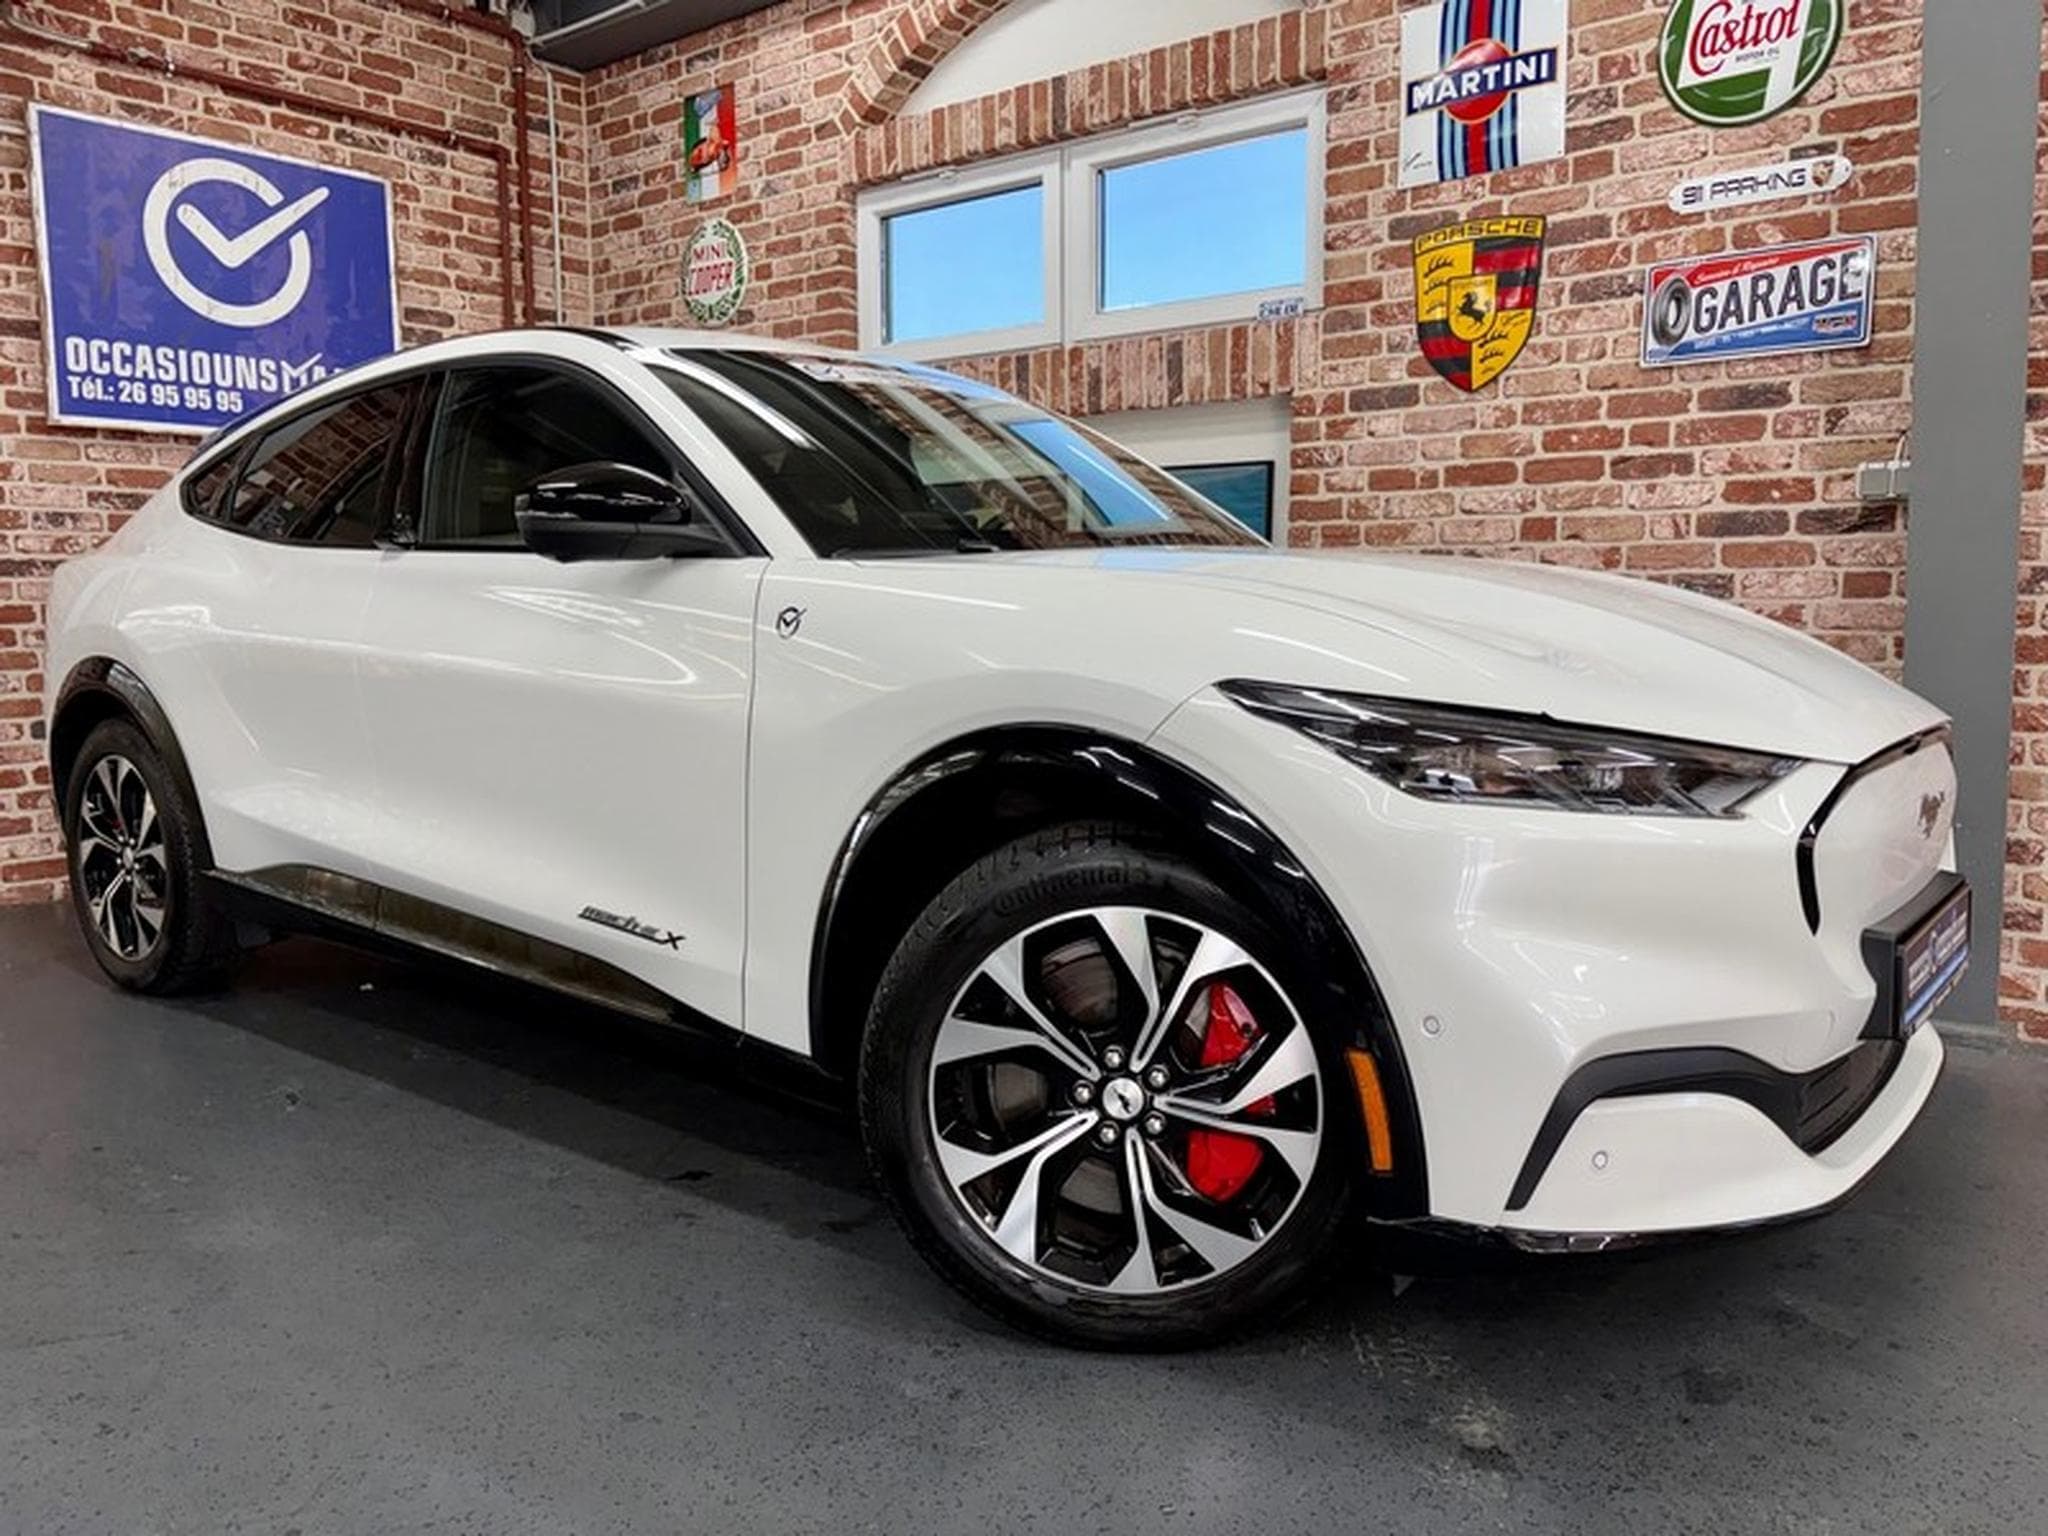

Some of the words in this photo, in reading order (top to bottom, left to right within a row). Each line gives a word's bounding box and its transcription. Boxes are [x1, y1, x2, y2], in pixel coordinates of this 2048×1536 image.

[1689, 0, 1800, 77] Castrol
[1412, 53, 1549, 110] MARTINI
[1710, 168, 1806, 200] PARKING
[1418, 219, 1538, 251] PORSCHE
[1693, 251, 1865, 334] GARAGE
[118, 380, 147, 404] 26
[151, 383, 180, 408] 95
[184, 387, 213, 412] 95
[216, 390, 244, 414] 95
